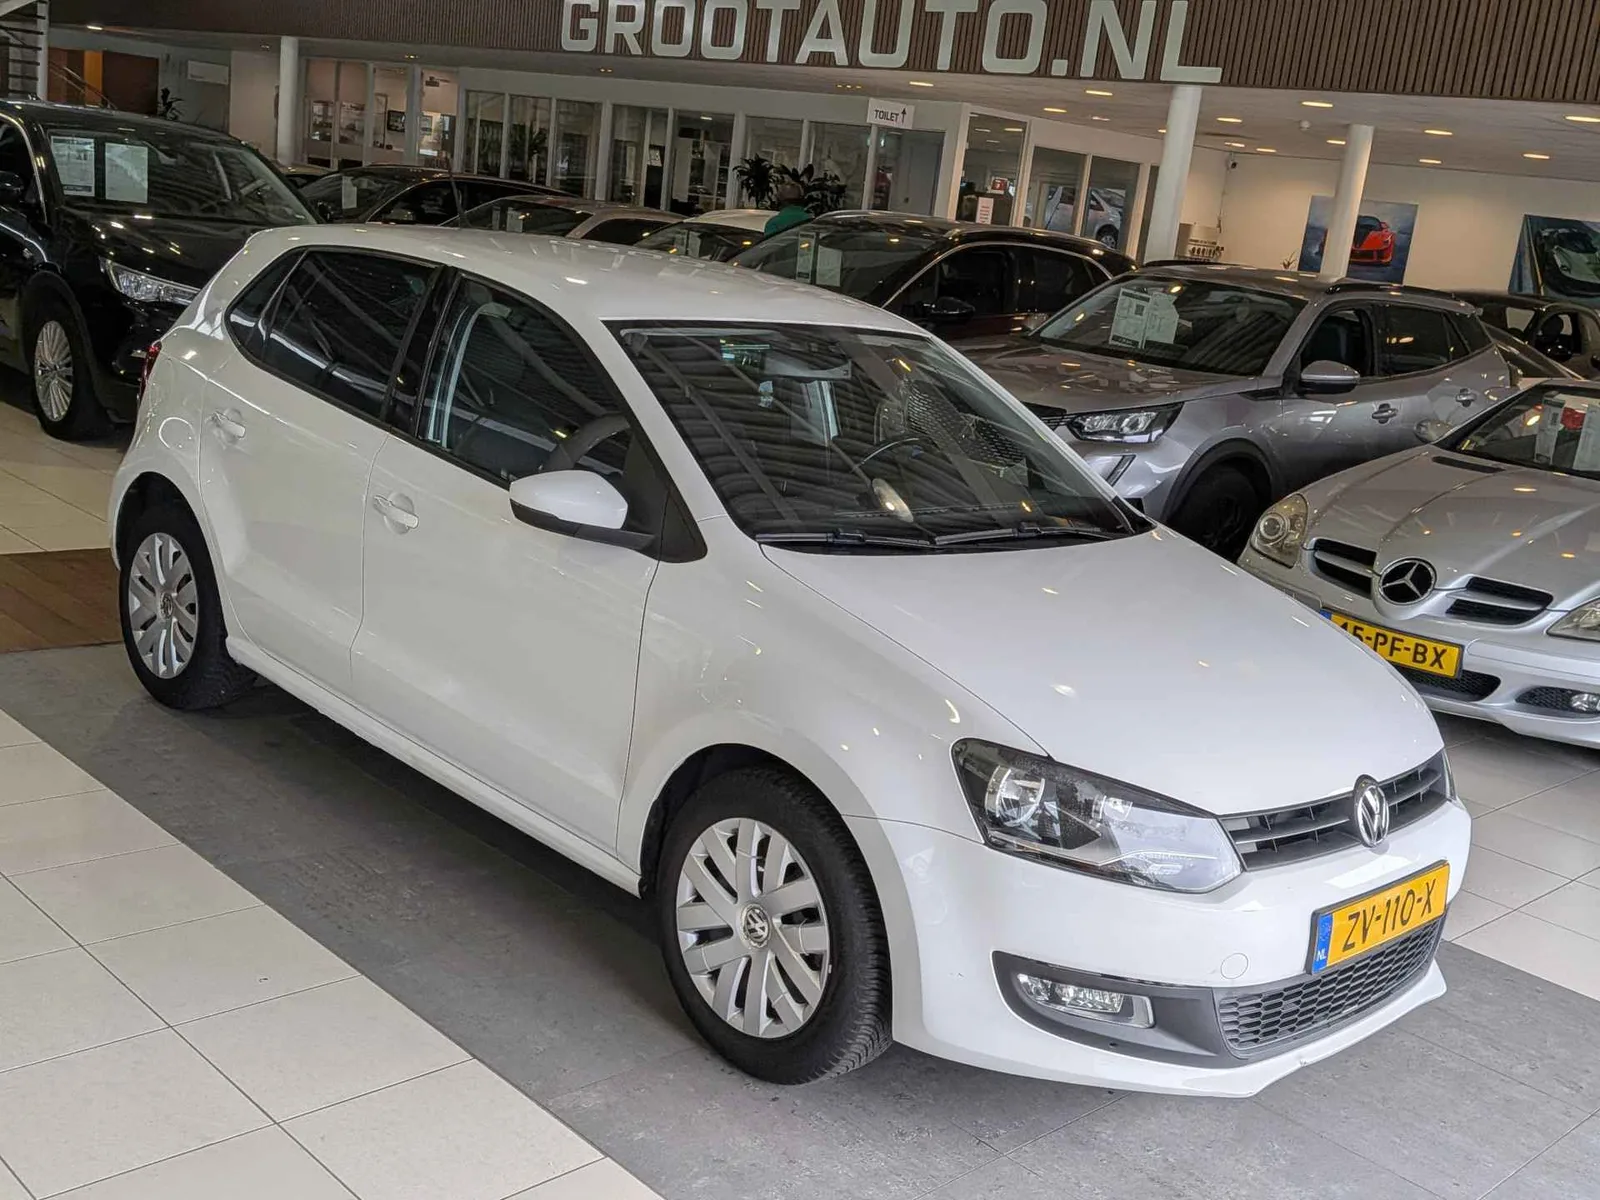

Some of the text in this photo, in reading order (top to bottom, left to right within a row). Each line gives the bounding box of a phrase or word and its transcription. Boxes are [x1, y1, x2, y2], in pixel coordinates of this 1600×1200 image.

[561, 0, 1222, 83] GROOTAUTO.NL
[874, 109, 899, 122] TOILET
[1342, 878, 1436, 952] ZV-110-X
[1316, 947, 1327, 962] NL
